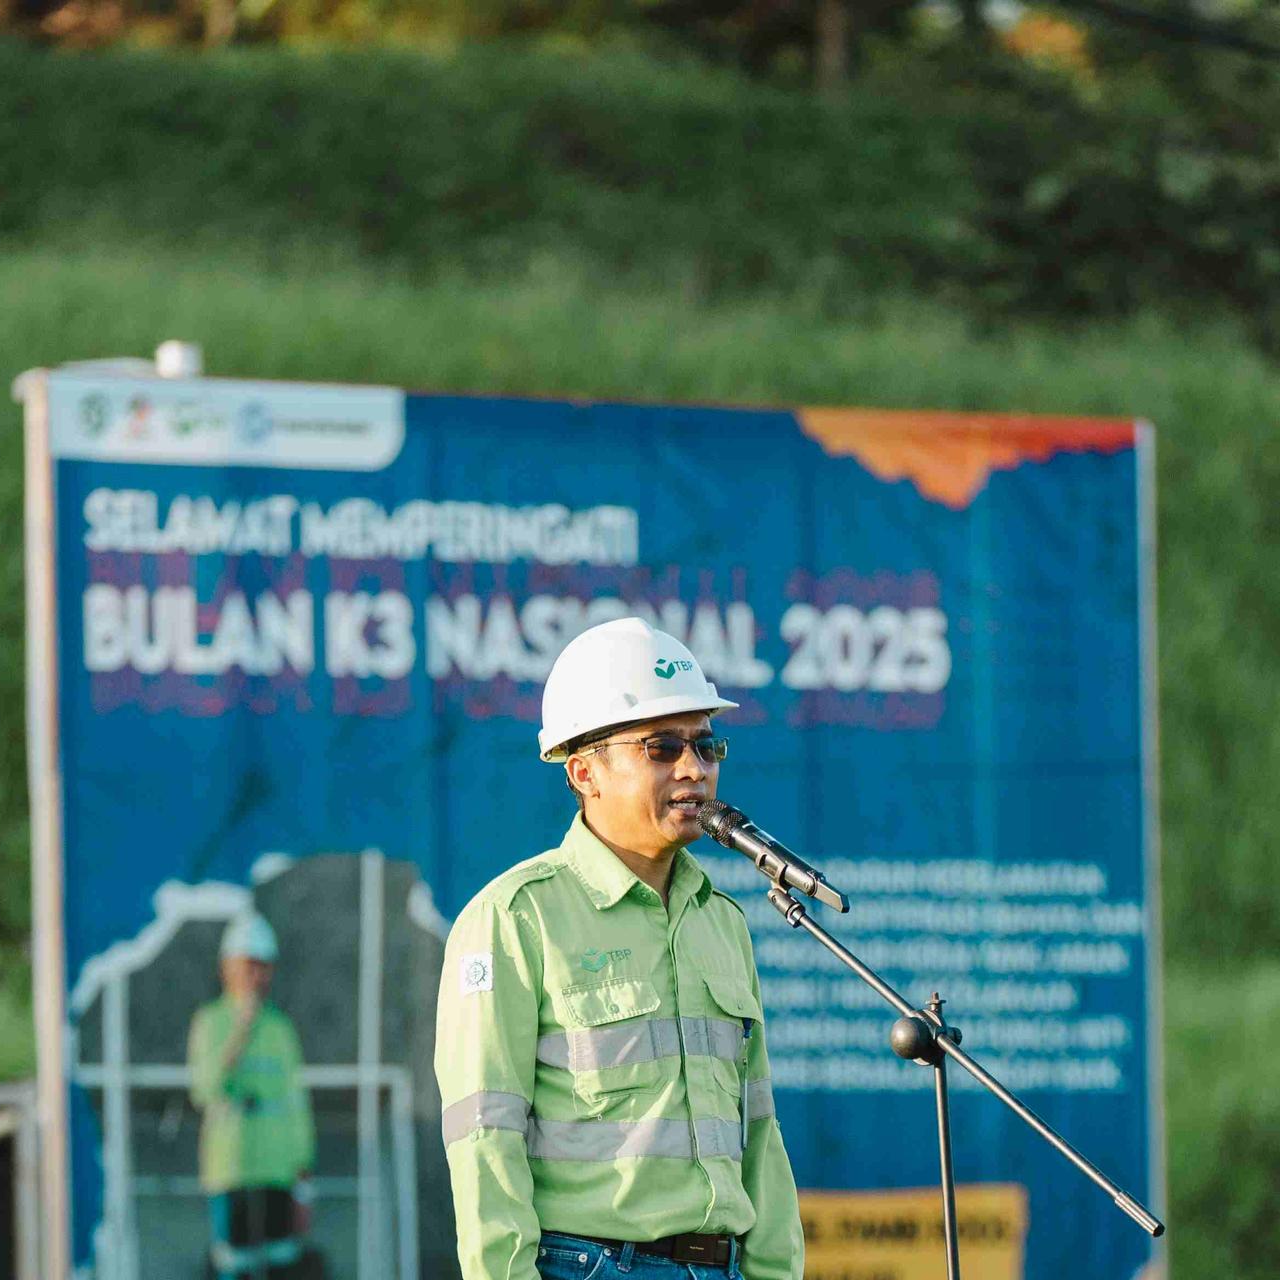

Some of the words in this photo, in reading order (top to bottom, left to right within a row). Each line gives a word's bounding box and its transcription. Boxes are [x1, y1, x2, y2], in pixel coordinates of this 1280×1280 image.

[84, 488, 296, 556] SELAMAT
[300, 498, 639, 566] MEMPERINGATI
[83, 586, 314, 676] BULAN
[324, 590, 415, 678] K3
[780, 603, 951, 692] 2025
[673, 660, 693, 671] TBP
[607, 948, 631, 961] TBP
